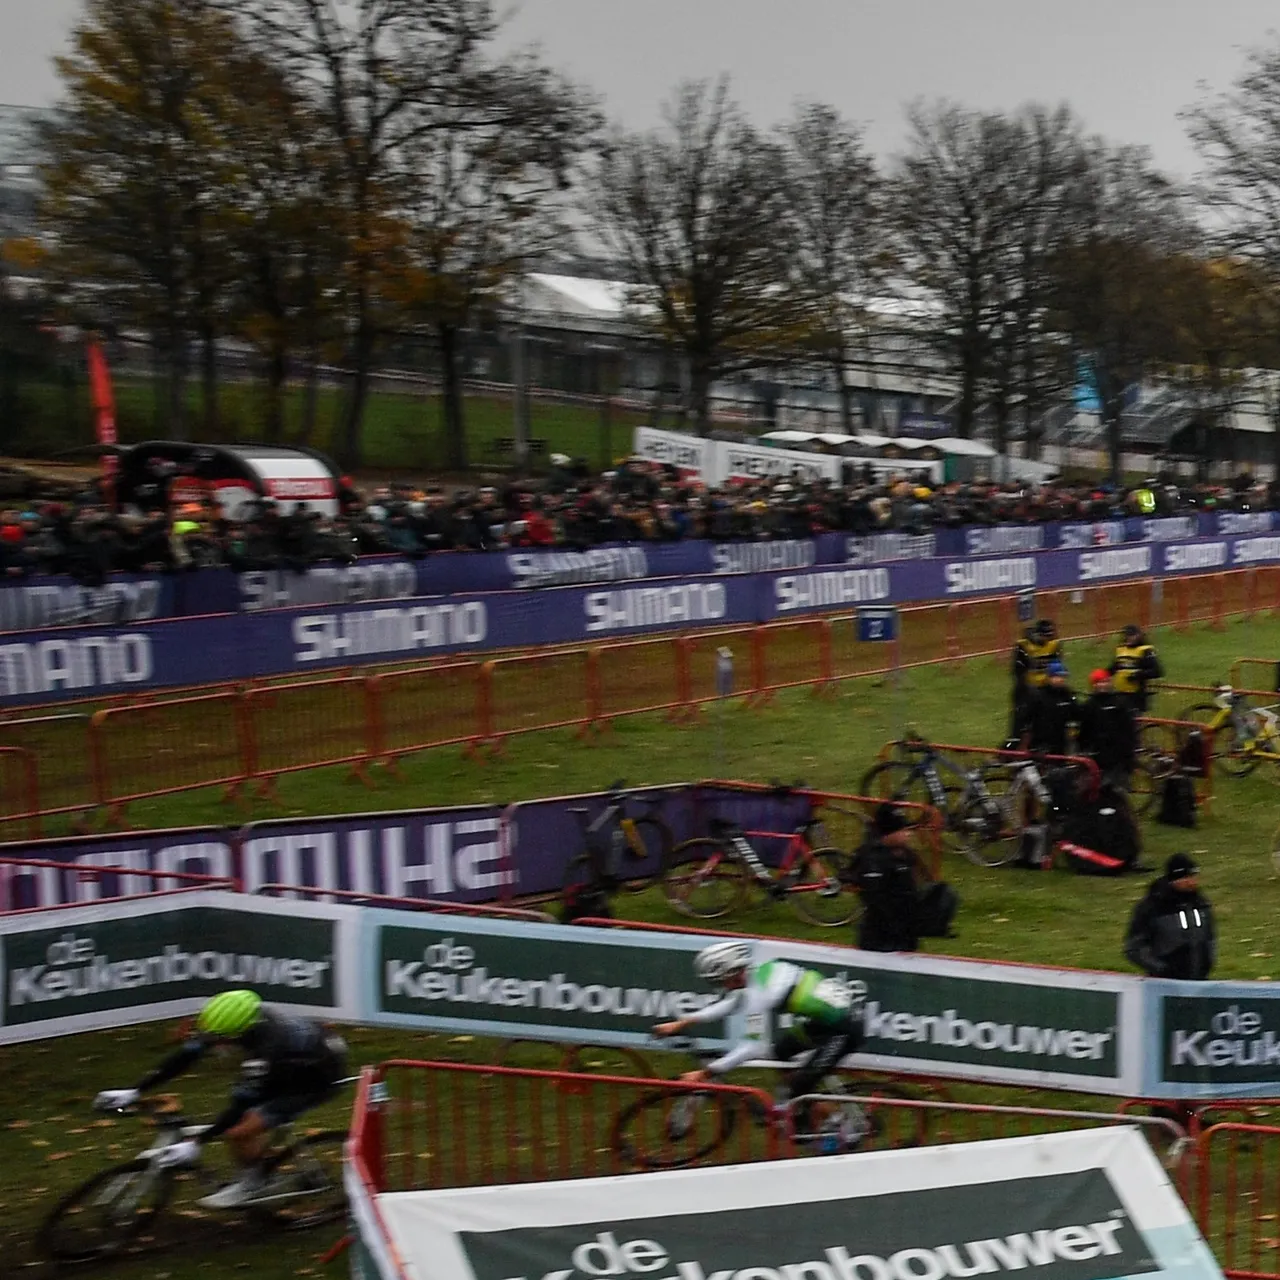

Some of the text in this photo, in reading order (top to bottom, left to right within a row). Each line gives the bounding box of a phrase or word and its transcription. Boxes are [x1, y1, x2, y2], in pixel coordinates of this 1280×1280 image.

[775, 568, 889, 611] SHIMANO
[945, 557, 1037, 593] SHIMANO
[584, 583, 727, 632] SHIMANO
[293, 606, 488, 662] SHIMANO
[47, 933, 97, 967] de
[423, 937, 475, 970] de
[9, 944, 329, 1005] Keukenbouwer
[864, 1000, 1111, 1060] kenbouwer
[1211, 1005, 1261, 1036] de
[571, 1230, 671, 1276] de
